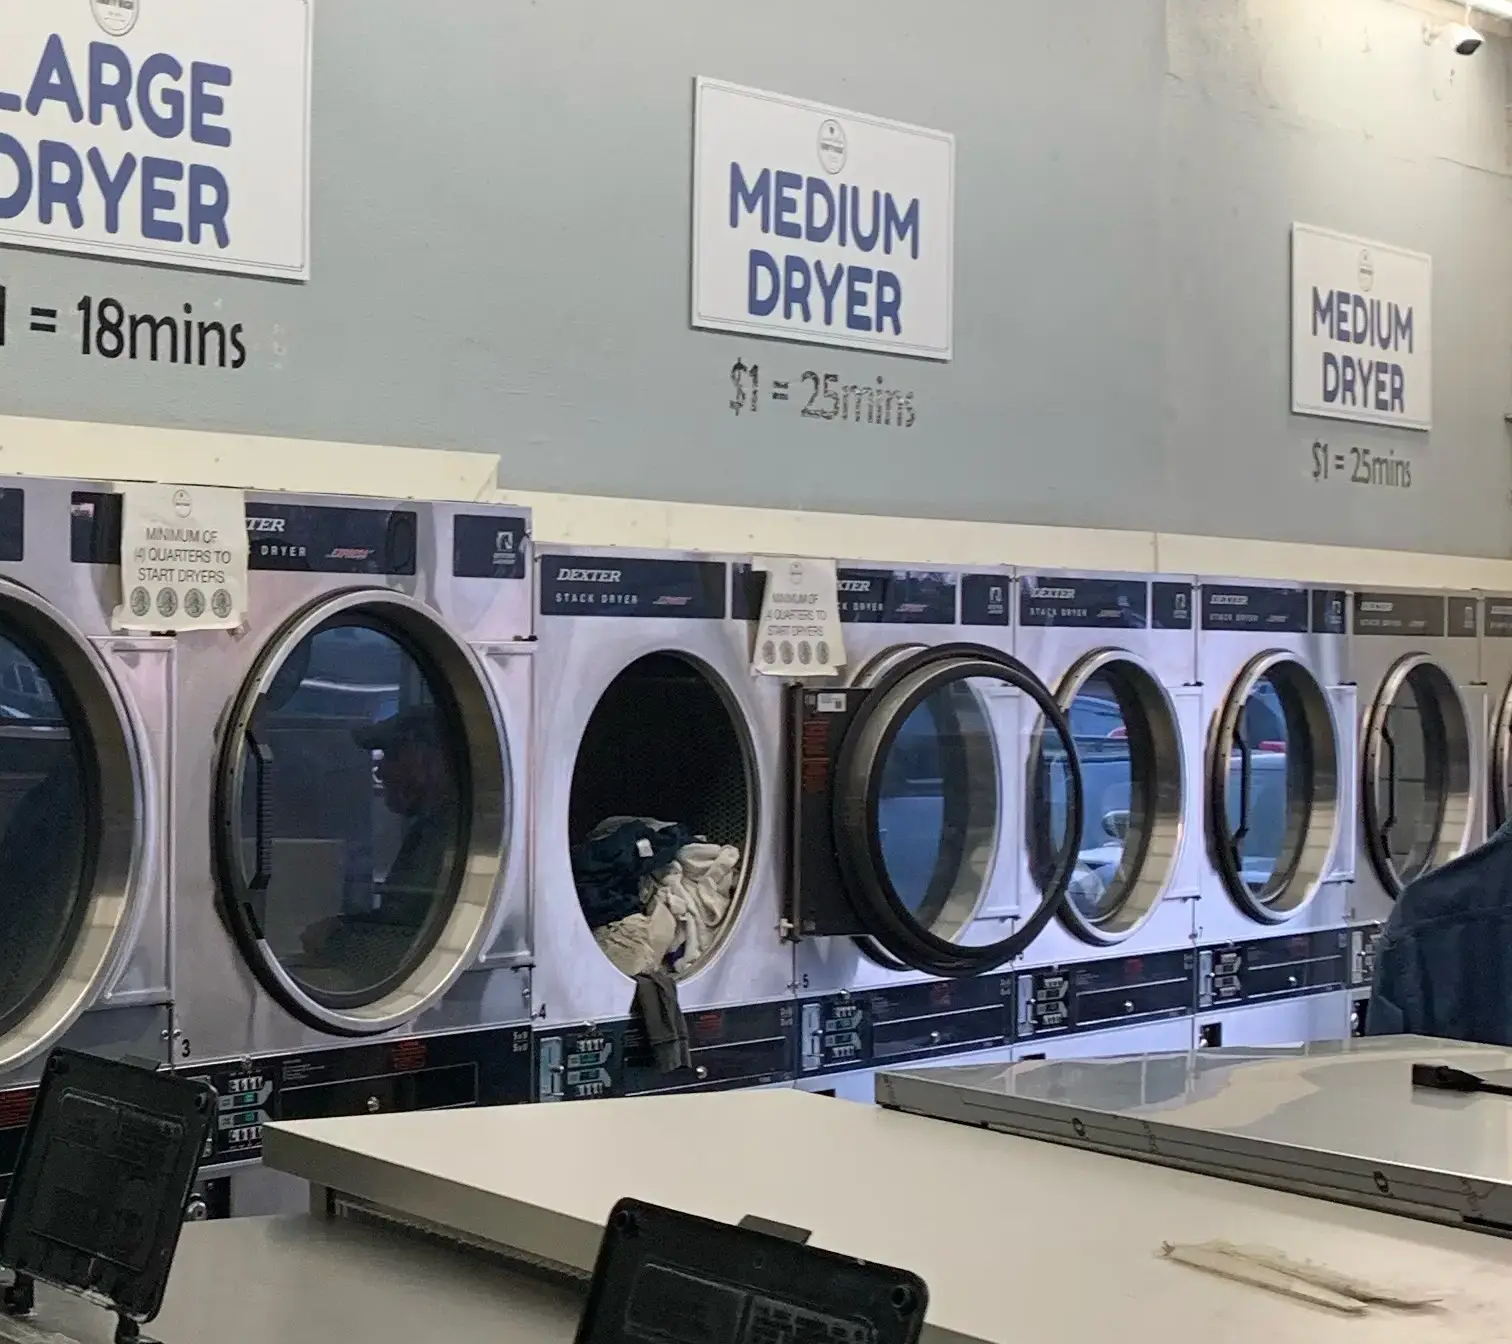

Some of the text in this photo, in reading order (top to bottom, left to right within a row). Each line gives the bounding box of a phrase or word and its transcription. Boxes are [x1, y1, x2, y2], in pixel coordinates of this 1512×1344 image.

[729, 161, 920, 260] MEDIUM
[748, 248, 902, 336] DRYER
[1312, 286, 1413, 354] MEDIUM
[30, 307, 58, 333] =
[77, 295, 246, 369] 18mins
[728, 357, 917, 428] $1 = 25mins
[1323, 352, 1405, 413] DRYER
[1350, 446, 1412, 488] 25mins
[245, 517, 286, 532] TER
[146, 527, 218, 543] MINIMUM OF
[148, 547, 211, 564] QUARTERS
[215, 550, 232, 564] TO
[261, 545, 306, 557] DRYER
[138, 567, 225, 584] START DRYERS
[557, 568, 621, 582] DEXTER
[556, 592, 595, 603] STACK
[181, 1038, 192, 1058] 3
